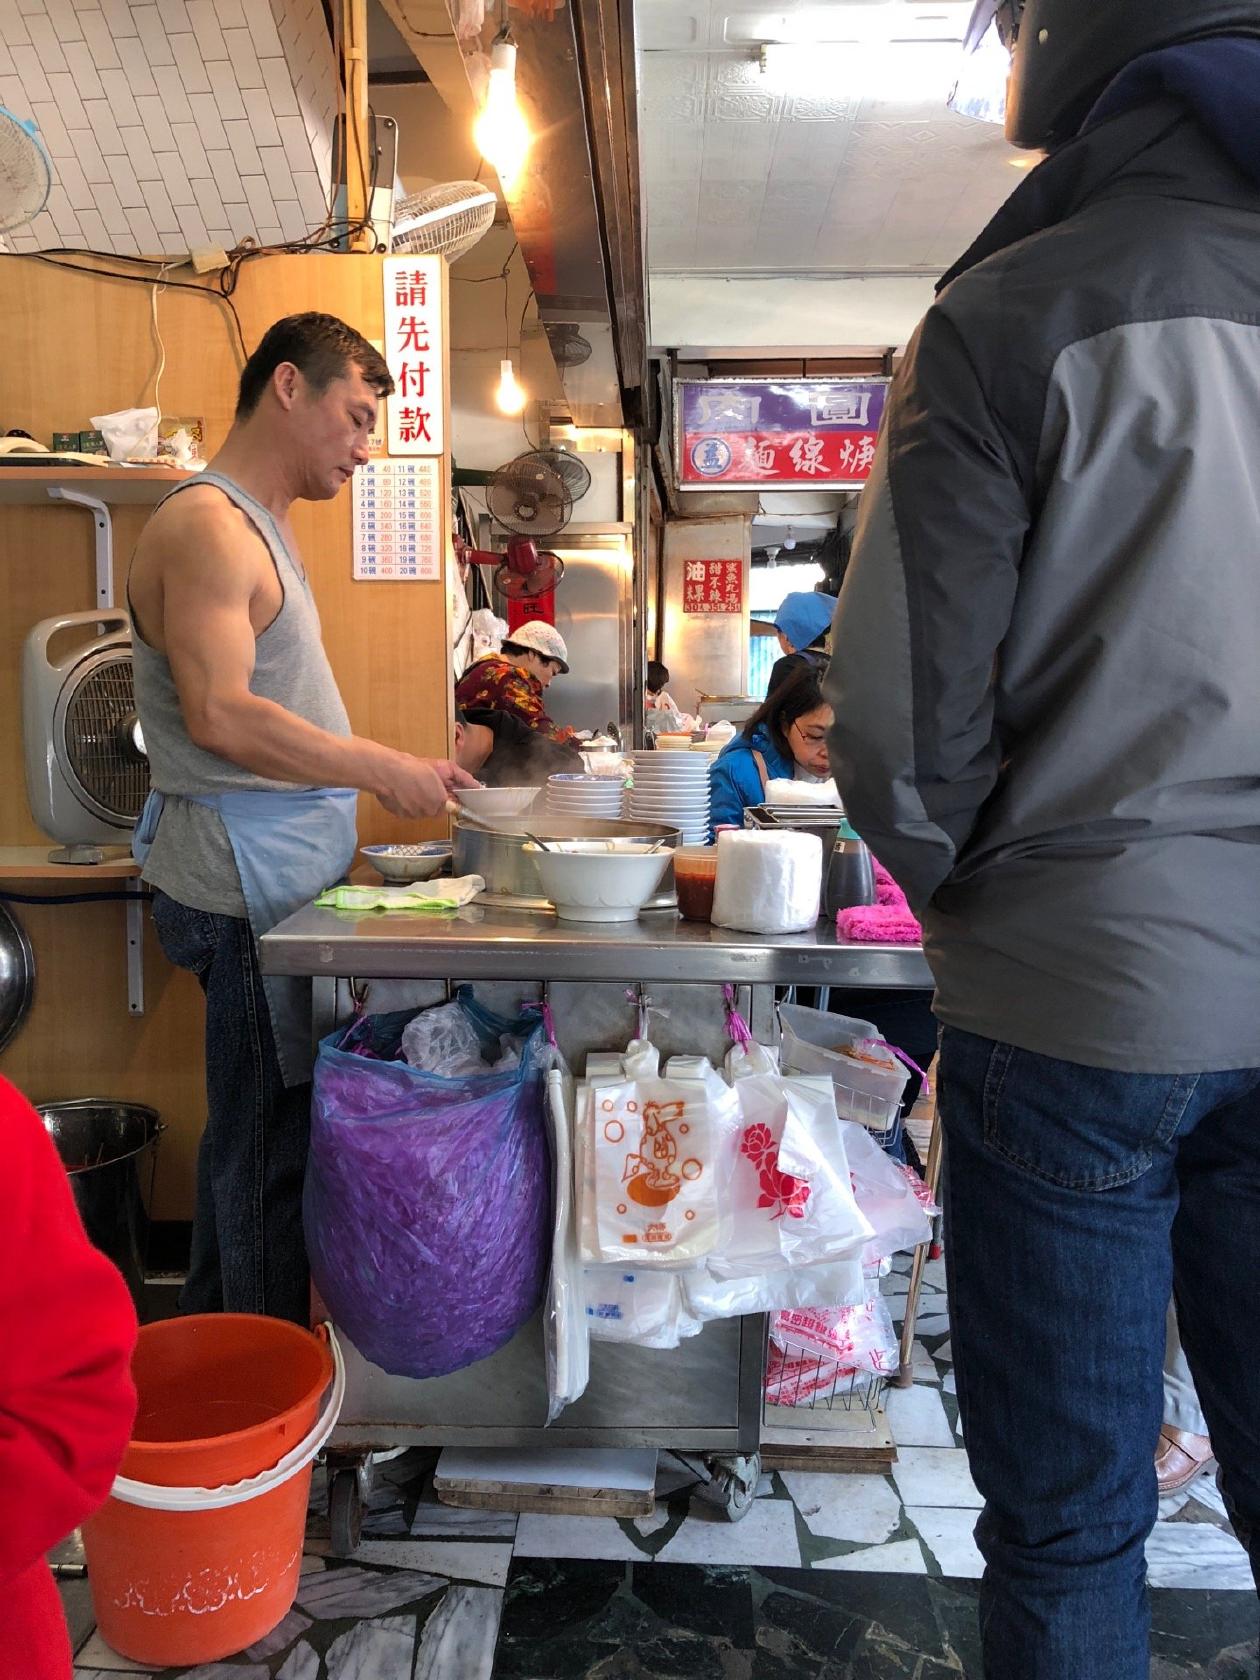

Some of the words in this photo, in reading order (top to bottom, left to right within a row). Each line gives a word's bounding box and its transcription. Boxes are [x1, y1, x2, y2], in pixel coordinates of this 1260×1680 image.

[395, 269, 432, 443] 請先付款
[696, 391, 872, 427] 肉圓
